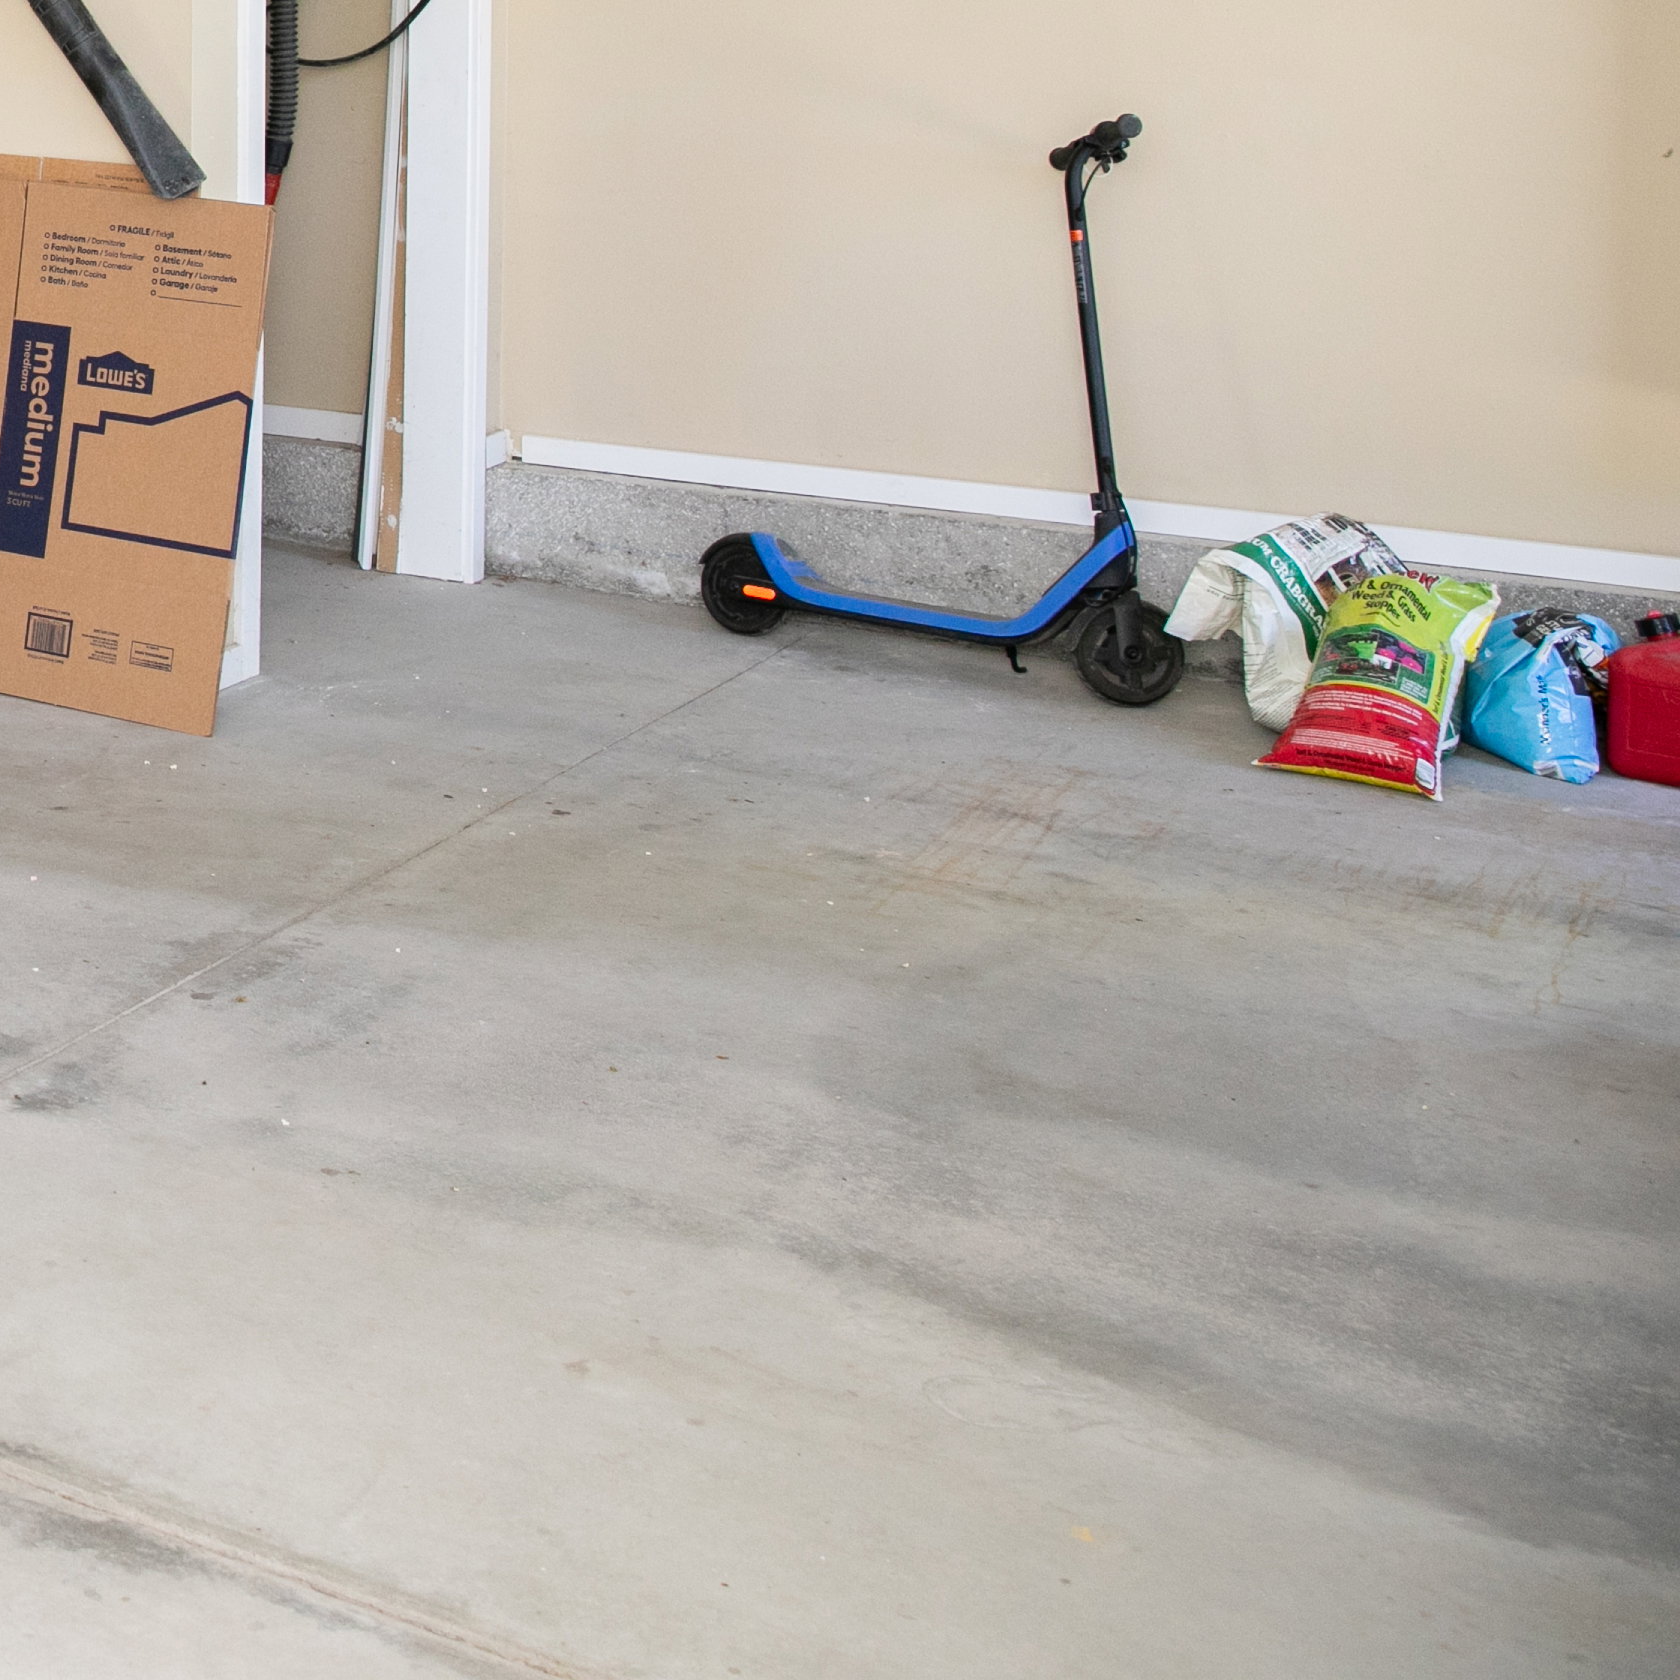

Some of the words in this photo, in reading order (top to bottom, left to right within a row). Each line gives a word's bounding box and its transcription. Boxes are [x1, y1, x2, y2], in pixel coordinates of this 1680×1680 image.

[117, 224, 150, 236] FRAGILE
[52, 231, 86, 243] Bedroom
[51, 243, 76, 255] Family
[77, 246, 99, 256] Room
[163, 244, 202, 256] Basement
[50, 254, 74, 266] Dining
[75, 257, 97, 267] Room
[162, 255, 181, 265] Attic
[48, 264, 78, 276] Kitchen
[160, 267, 194, 280] Laundry
[48, 276, 66, 286] Bath
[159, 278, 190, 290] Garage
[20, 340, 32, 392] mediana
[86, 363, 146, 389] LOWE'S
[19, 341, 54, 487] medium
[1352, 590, 1385, 600] Weed
[1385, 591, 1395, 600] &
[1398, 596, 1417, 623] Grass
[1367, 579, 1376, 590] &
[1381, 581, 1432, 621] Ornamental
